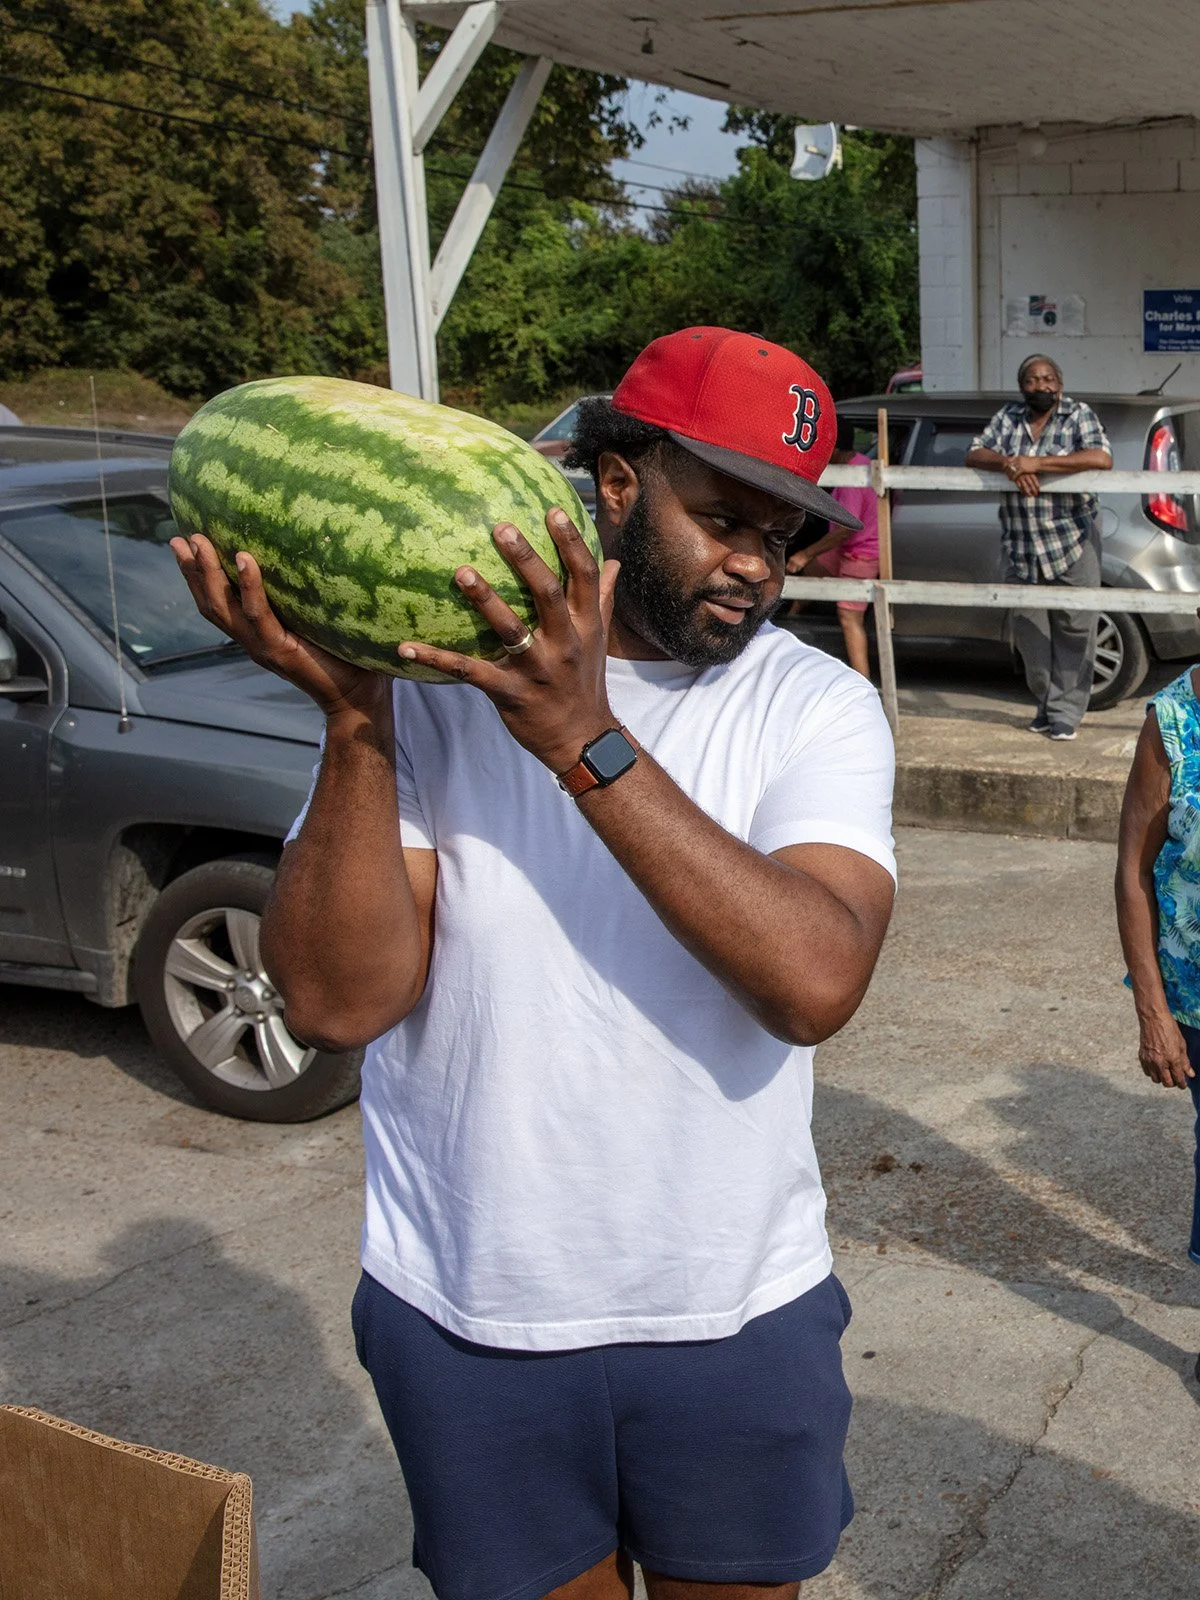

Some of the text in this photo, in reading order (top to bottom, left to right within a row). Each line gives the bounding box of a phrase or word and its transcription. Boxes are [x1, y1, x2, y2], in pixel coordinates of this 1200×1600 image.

[1173, 294, 1193, 304] Vote
[1145, 310, 1193, 321] Charles
[1159, 323, 1173, 332] for
[782, 384, 822, 452] B
